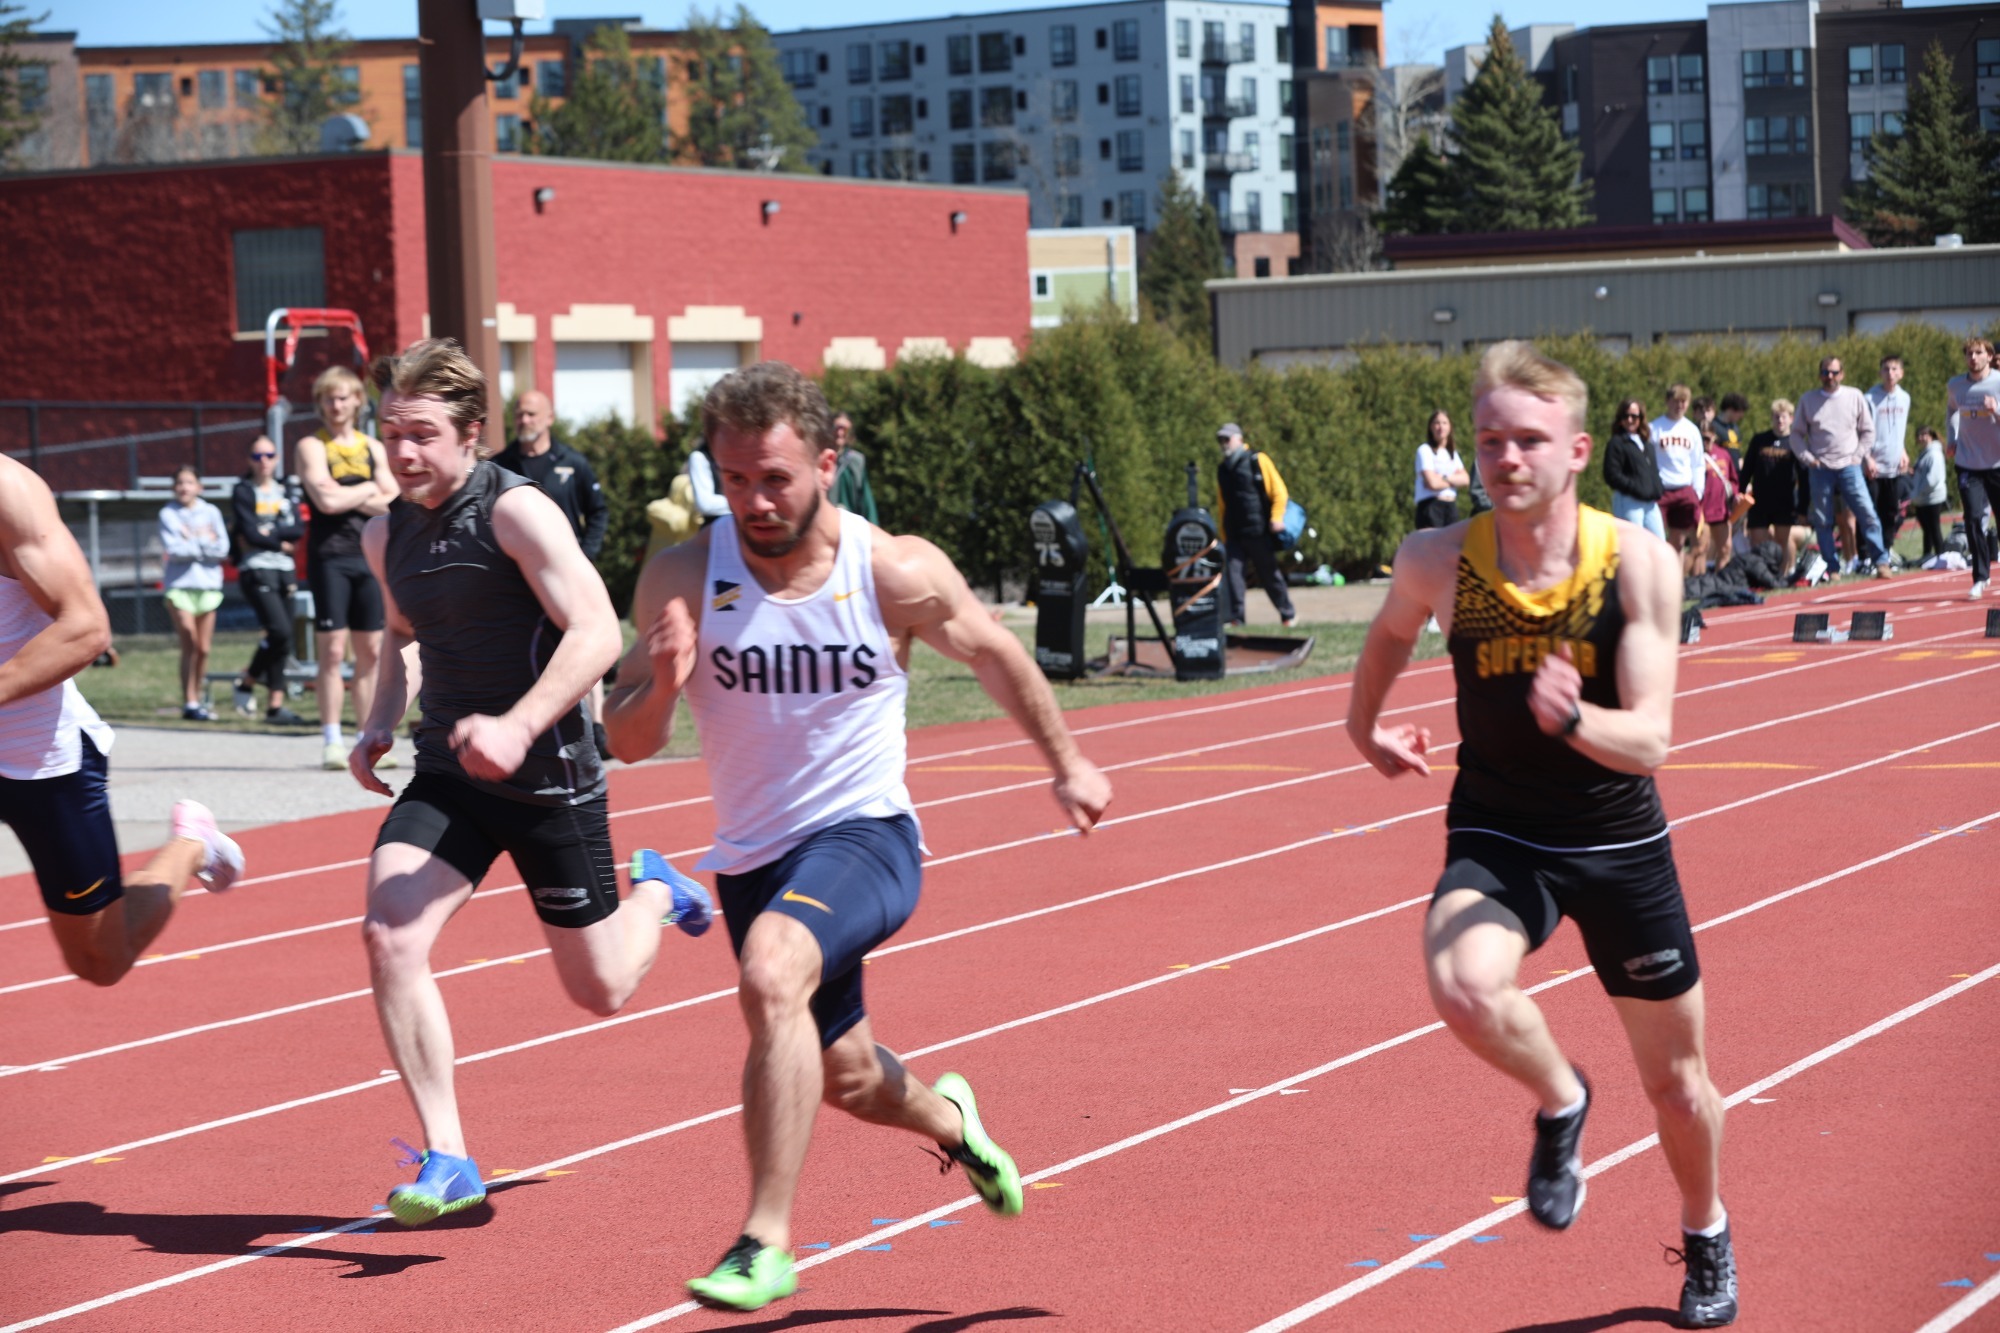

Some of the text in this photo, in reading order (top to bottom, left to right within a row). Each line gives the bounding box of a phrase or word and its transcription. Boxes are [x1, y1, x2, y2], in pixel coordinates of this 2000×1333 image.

[1659, 436, 1691, 450] UMD
[1034, 542, 1065, 567] 75
[710, 643, 878, 694] SAINTS
